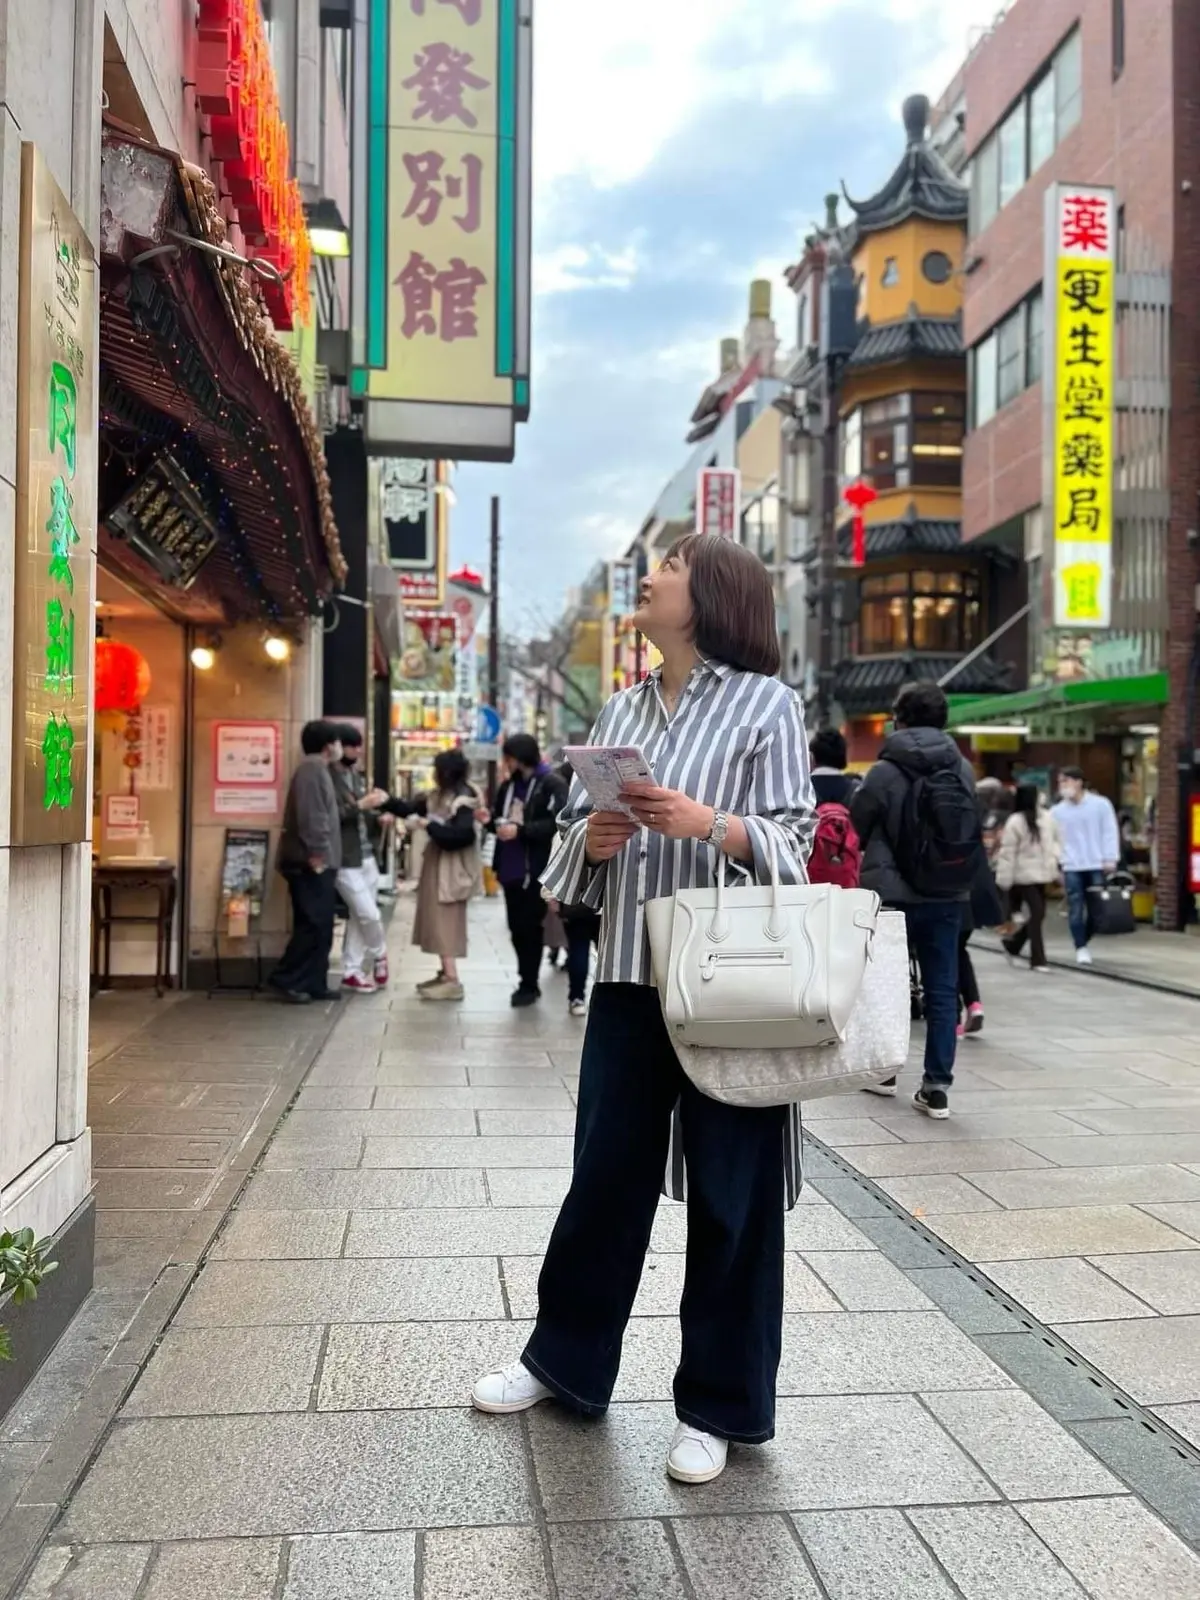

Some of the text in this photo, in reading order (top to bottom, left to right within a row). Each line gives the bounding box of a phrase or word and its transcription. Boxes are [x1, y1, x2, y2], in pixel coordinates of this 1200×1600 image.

[392, 0, 491, 342] 發別館
[1062, 196, 1108, 251] 薬
